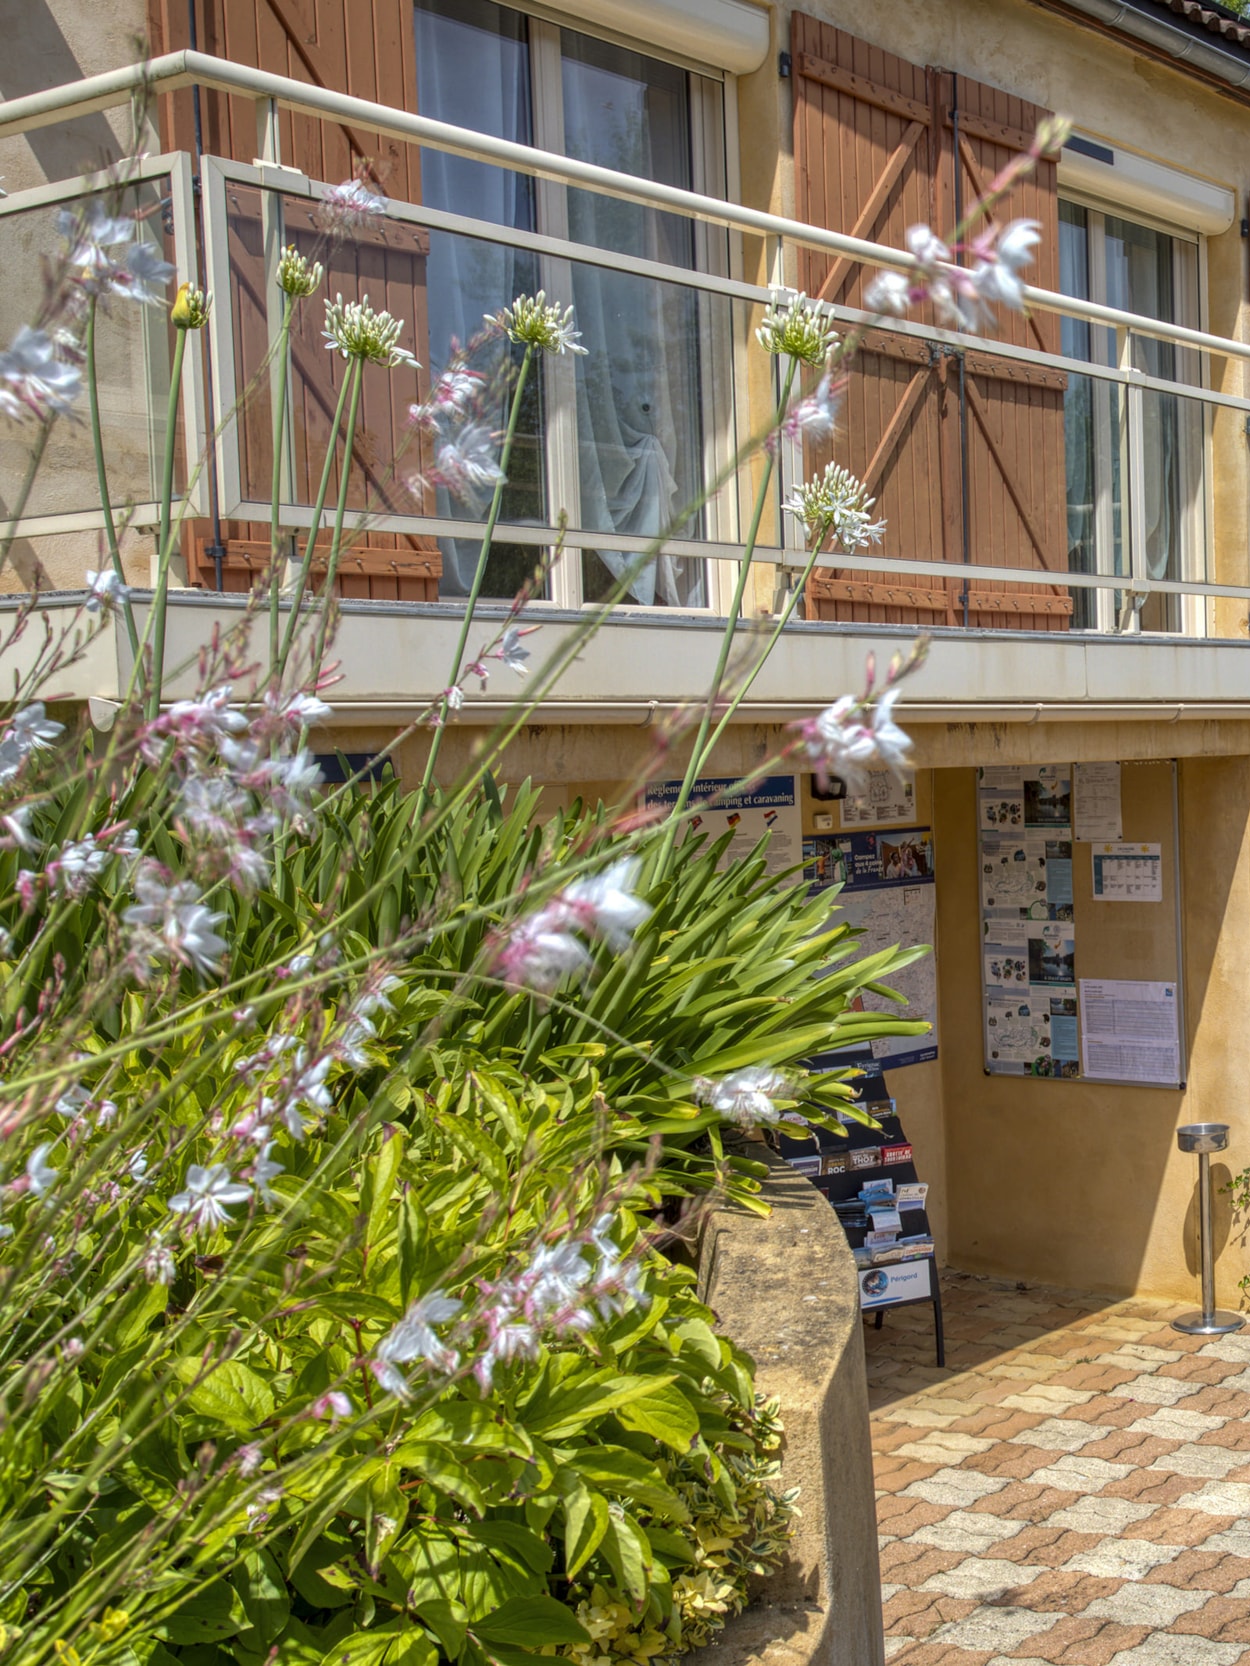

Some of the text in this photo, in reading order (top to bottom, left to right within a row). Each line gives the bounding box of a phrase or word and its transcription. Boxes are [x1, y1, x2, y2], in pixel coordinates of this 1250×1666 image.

[744, 796, 752, 805] et
[753, 793, 794, 806] caravaning
[827, 1166, 846, 1175] ROC
